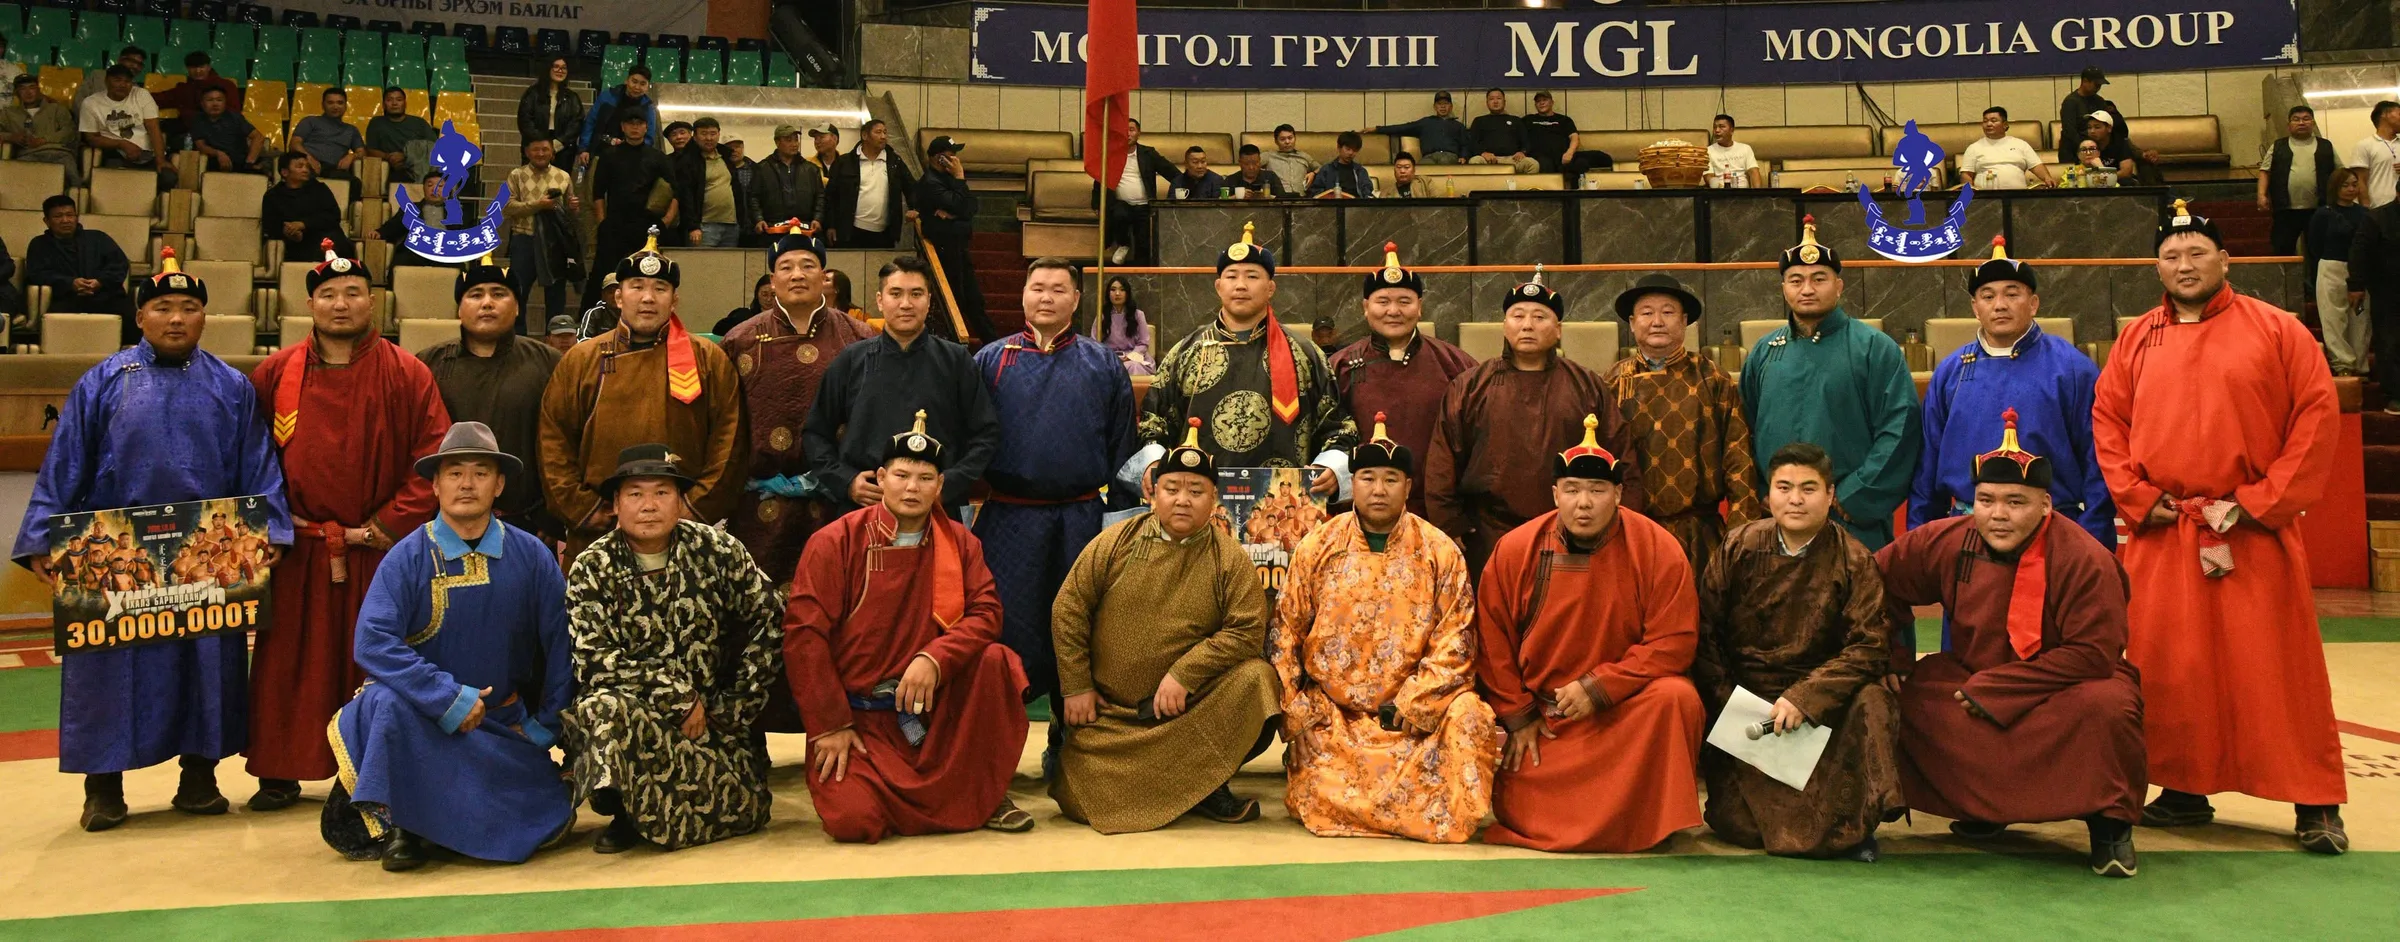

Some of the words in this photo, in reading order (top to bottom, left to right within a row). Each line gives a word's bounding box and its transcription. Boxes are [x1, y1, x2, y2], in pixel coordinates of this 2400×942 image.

[439, 0, 503, 15] ЭРХЭМ
[509, 4, 584, 19] БАЯЛАГ
[1270, 35, 1439, 68] ГРУПП
[1504, 20, 1698, 77] MGL
[1762, 21, 2040, 62] MONGOLIA
[2051, 10, 2235, 51] GROUP
